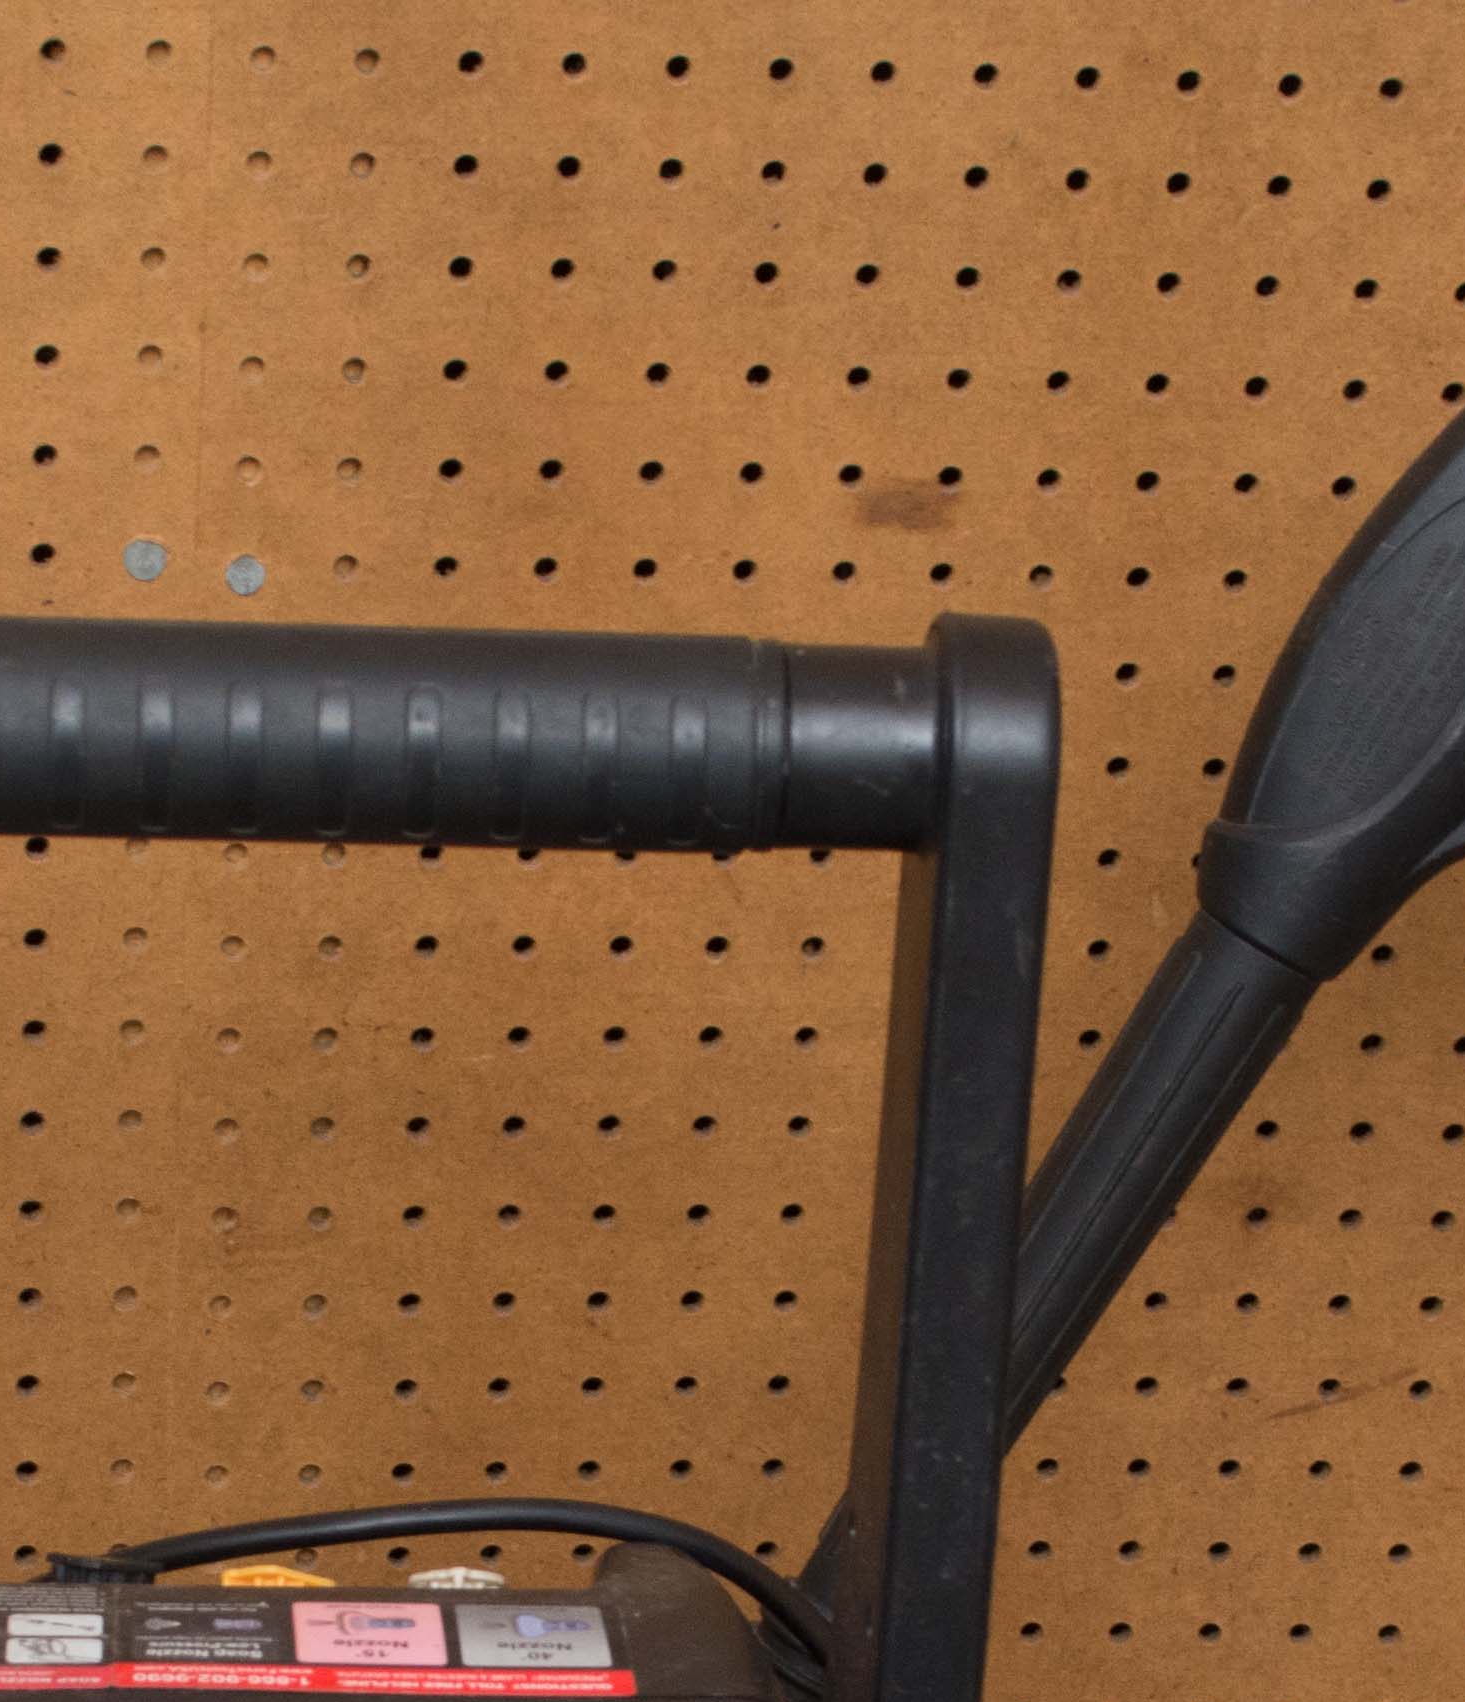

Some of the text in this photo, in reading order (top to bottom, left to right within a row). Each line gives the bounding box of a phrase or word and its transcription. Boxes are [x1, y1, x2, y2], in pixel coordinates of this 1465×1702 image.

[333, 1639, 409, 1648] Nozzle
[497, 1641, 572, 1652] Nozzle
[145, 1649, 263, 1659] Soap Nozzle
